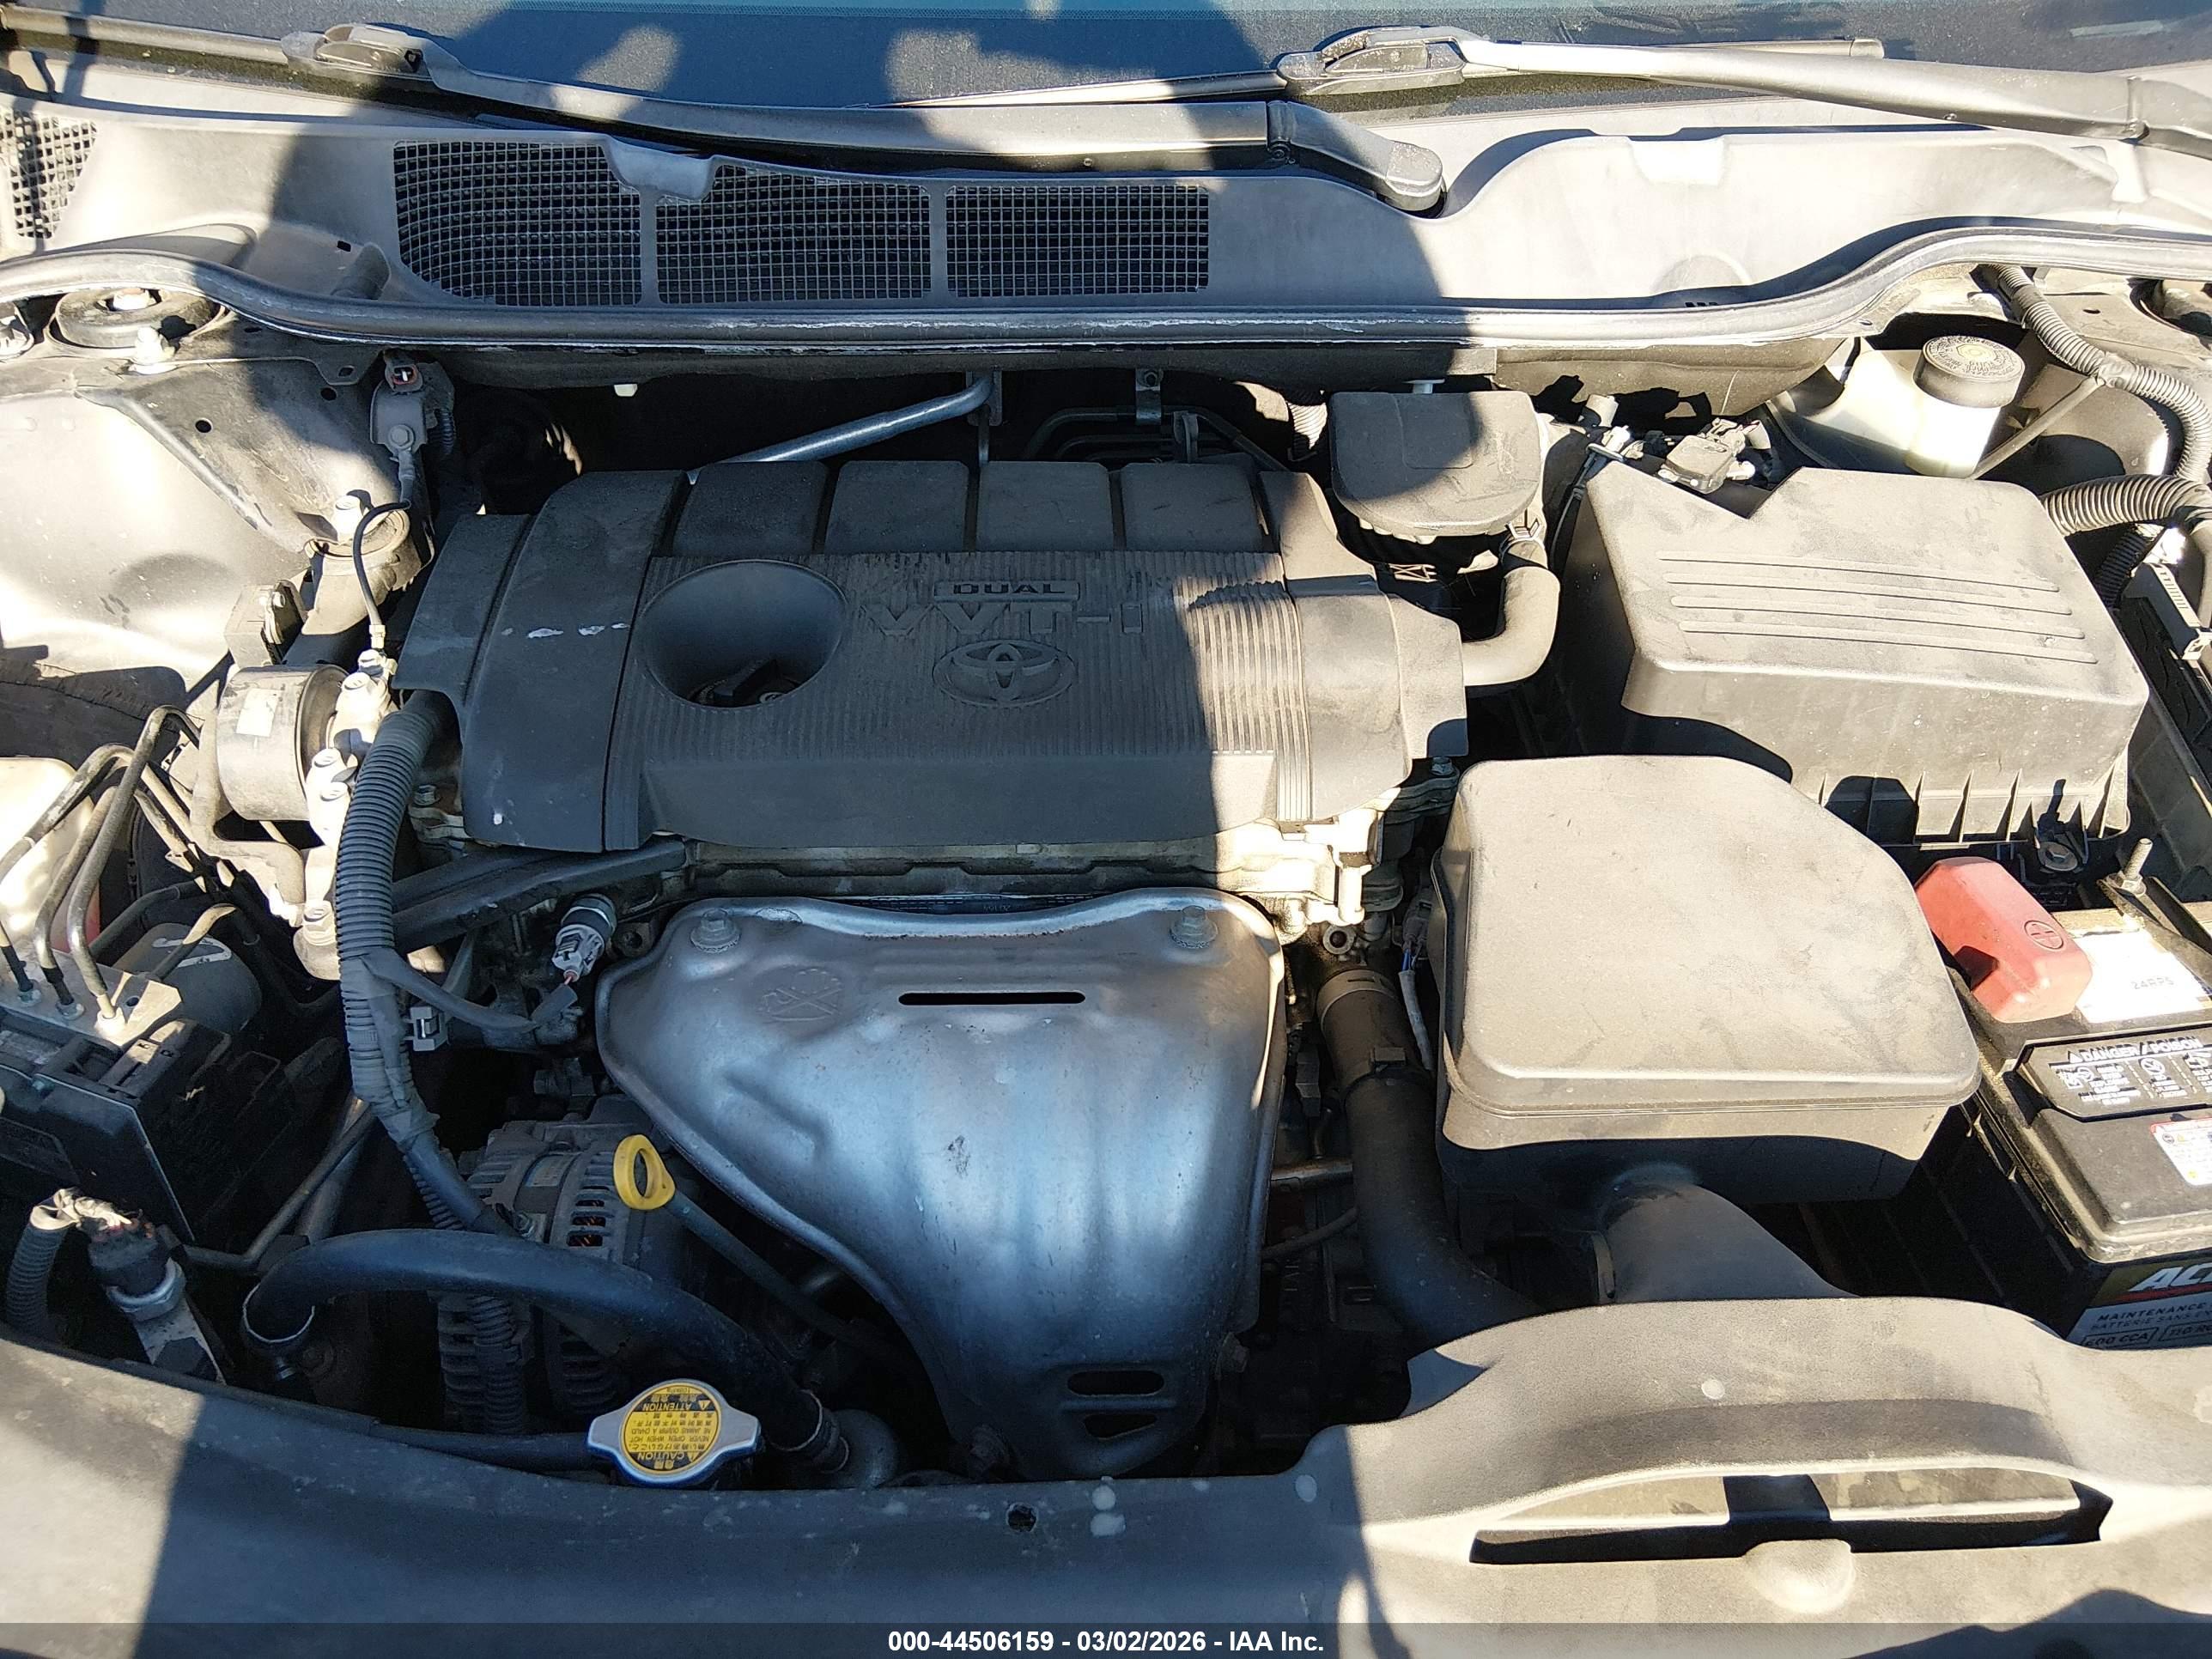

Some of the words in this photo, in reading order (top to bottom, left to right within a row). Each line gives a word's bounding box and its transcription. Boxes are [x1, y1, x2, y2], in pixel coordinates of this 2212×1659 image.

[953, 583, 1066, 594] DUAL
[2080, 1045, 2141, 1062] DANGER
[2149, 1037, 2204, 1054] POISON
[2097, 1302, 2207, 1322] MAINTENANCE
[2119, 1332, 2148, 1342] CCA
[641, 1401, 692, 1411] ATTENTION
[629, 1435, 644, 1443] HOT
[637, 1451, 685, 1460] CAUTION
